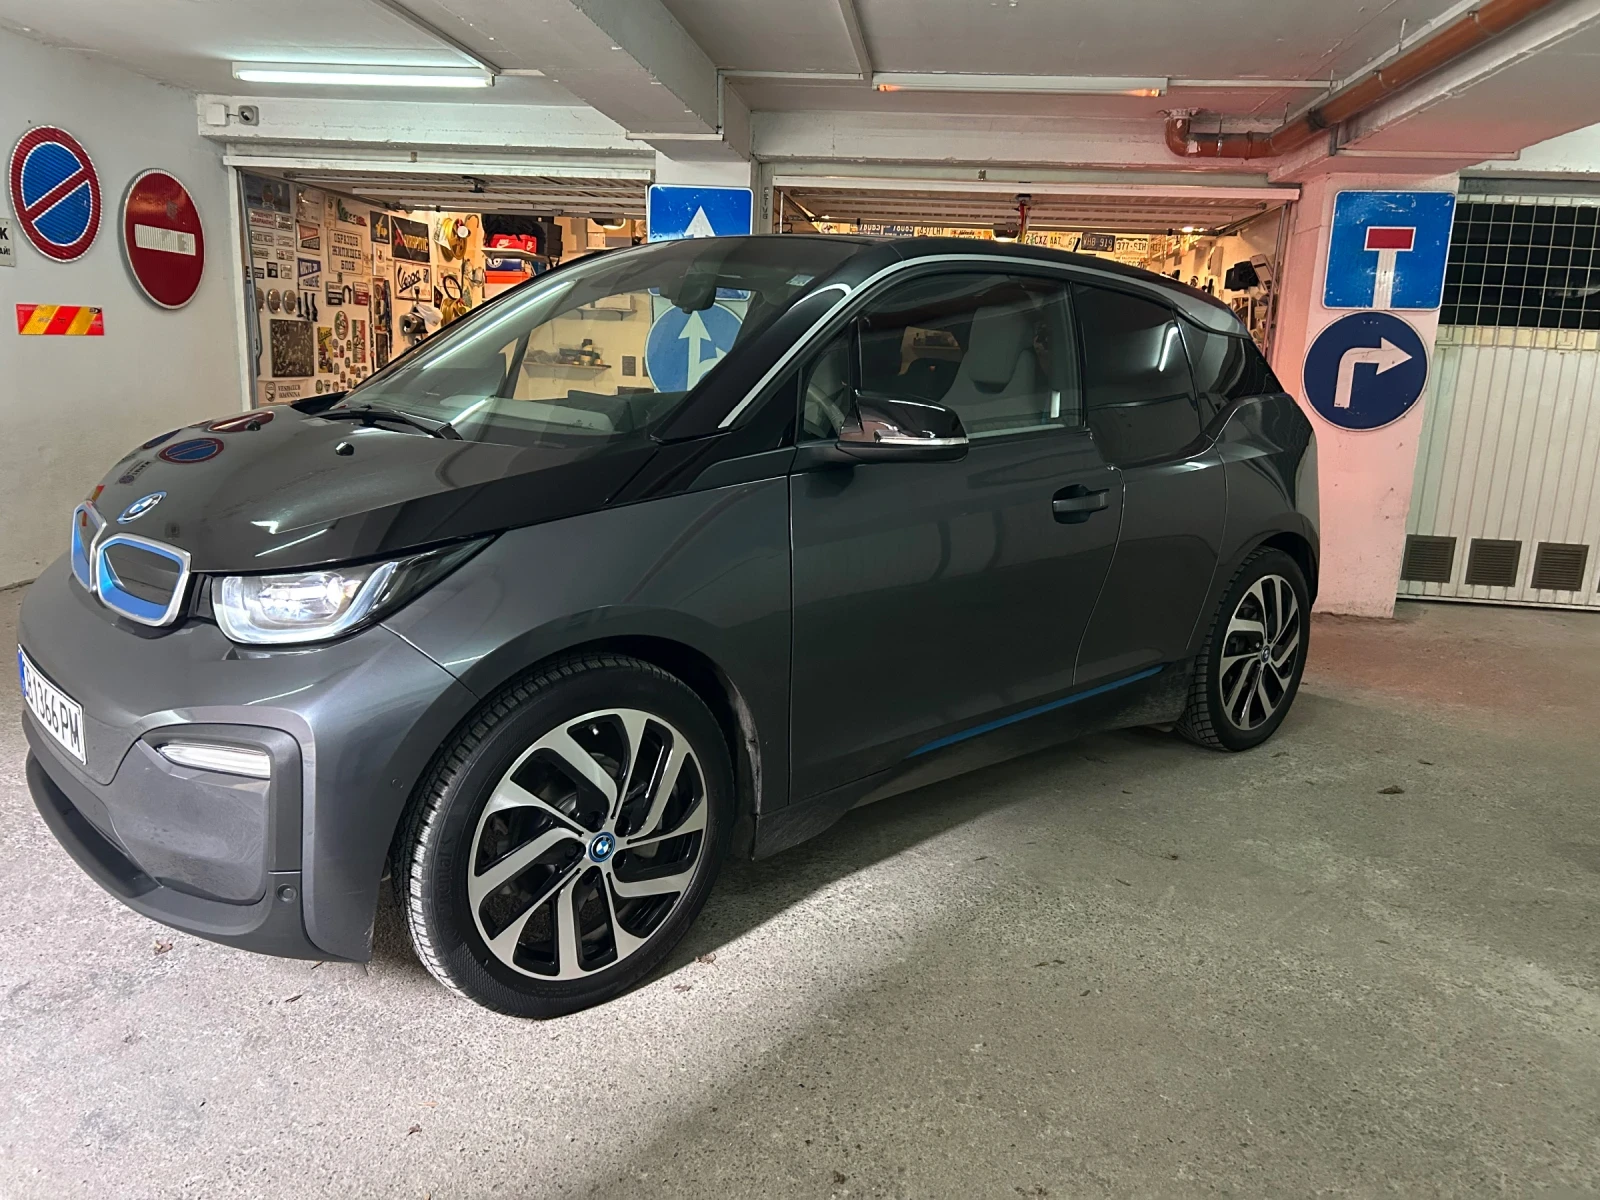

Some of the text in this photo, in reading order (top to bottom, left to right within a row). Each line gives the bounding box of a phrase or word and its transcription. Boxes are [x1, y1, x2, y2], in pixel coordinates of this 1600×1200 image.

[397, 264, 421, 293] Vespa
[32, 676, 59, 733] 1366
[59, 701, 81, 753] PM
